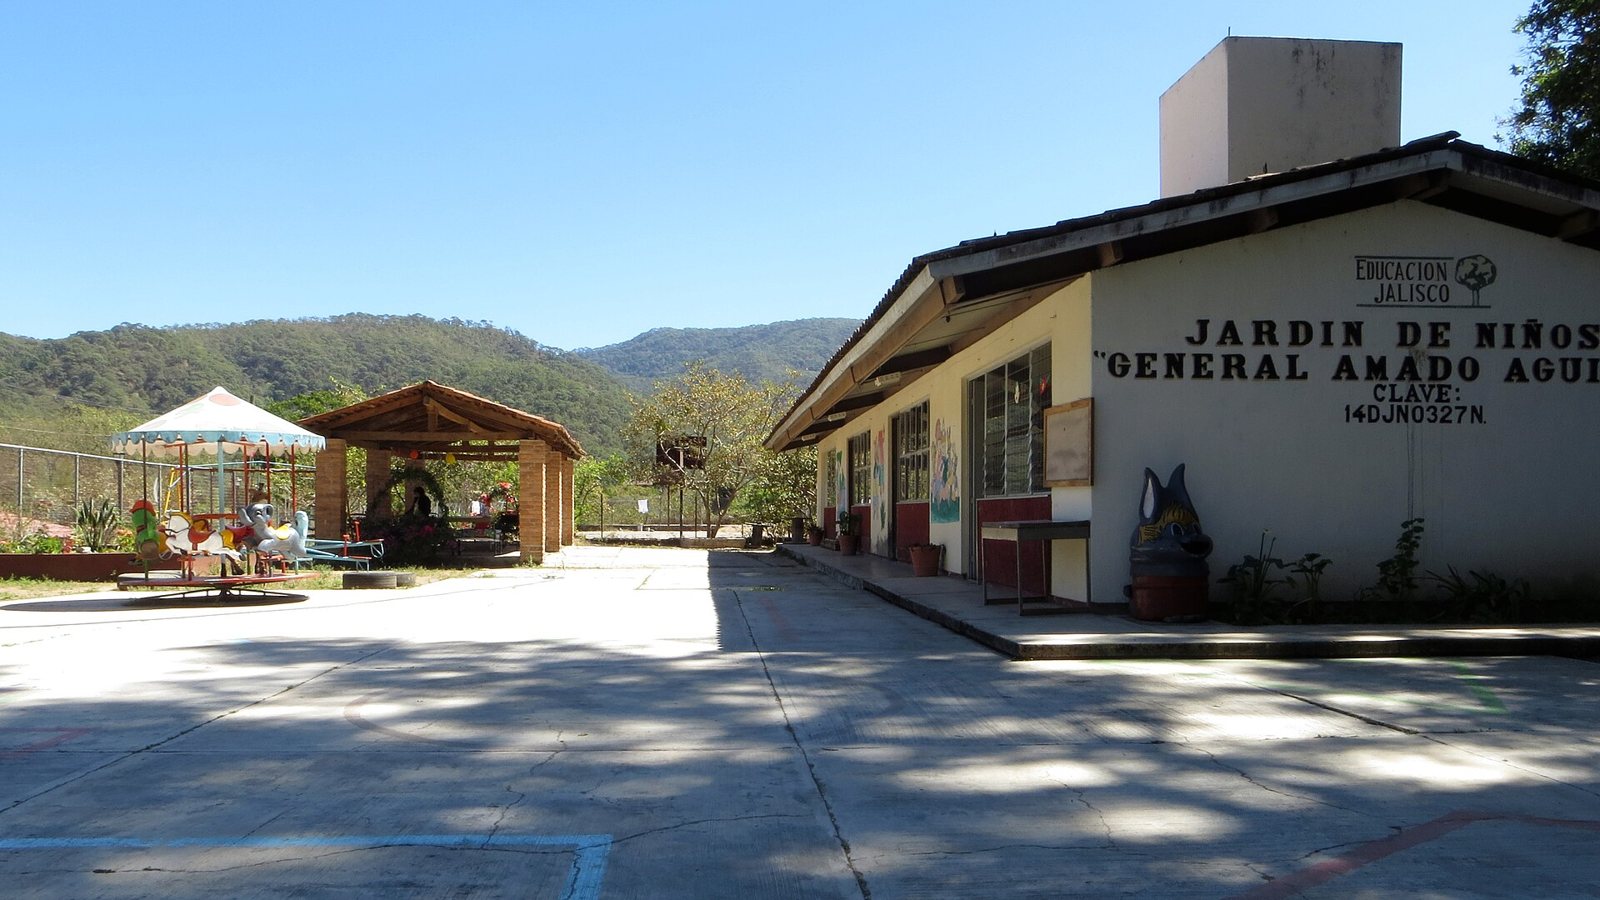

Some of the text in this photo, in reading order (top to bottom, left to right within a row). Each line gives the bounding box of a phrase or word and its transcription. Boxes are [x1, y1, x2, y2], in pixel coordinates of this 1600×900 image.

[1355, 259, 1448, 282] EDUCACION
[1373, 282, 1450, 303] JALISCO
[1185, 318, 1600, 350] JARDIN DE NIÑOS
[1331, 353, 1481, 383] AMADO
[1372, 383, 1461, 403] CLAVE:
